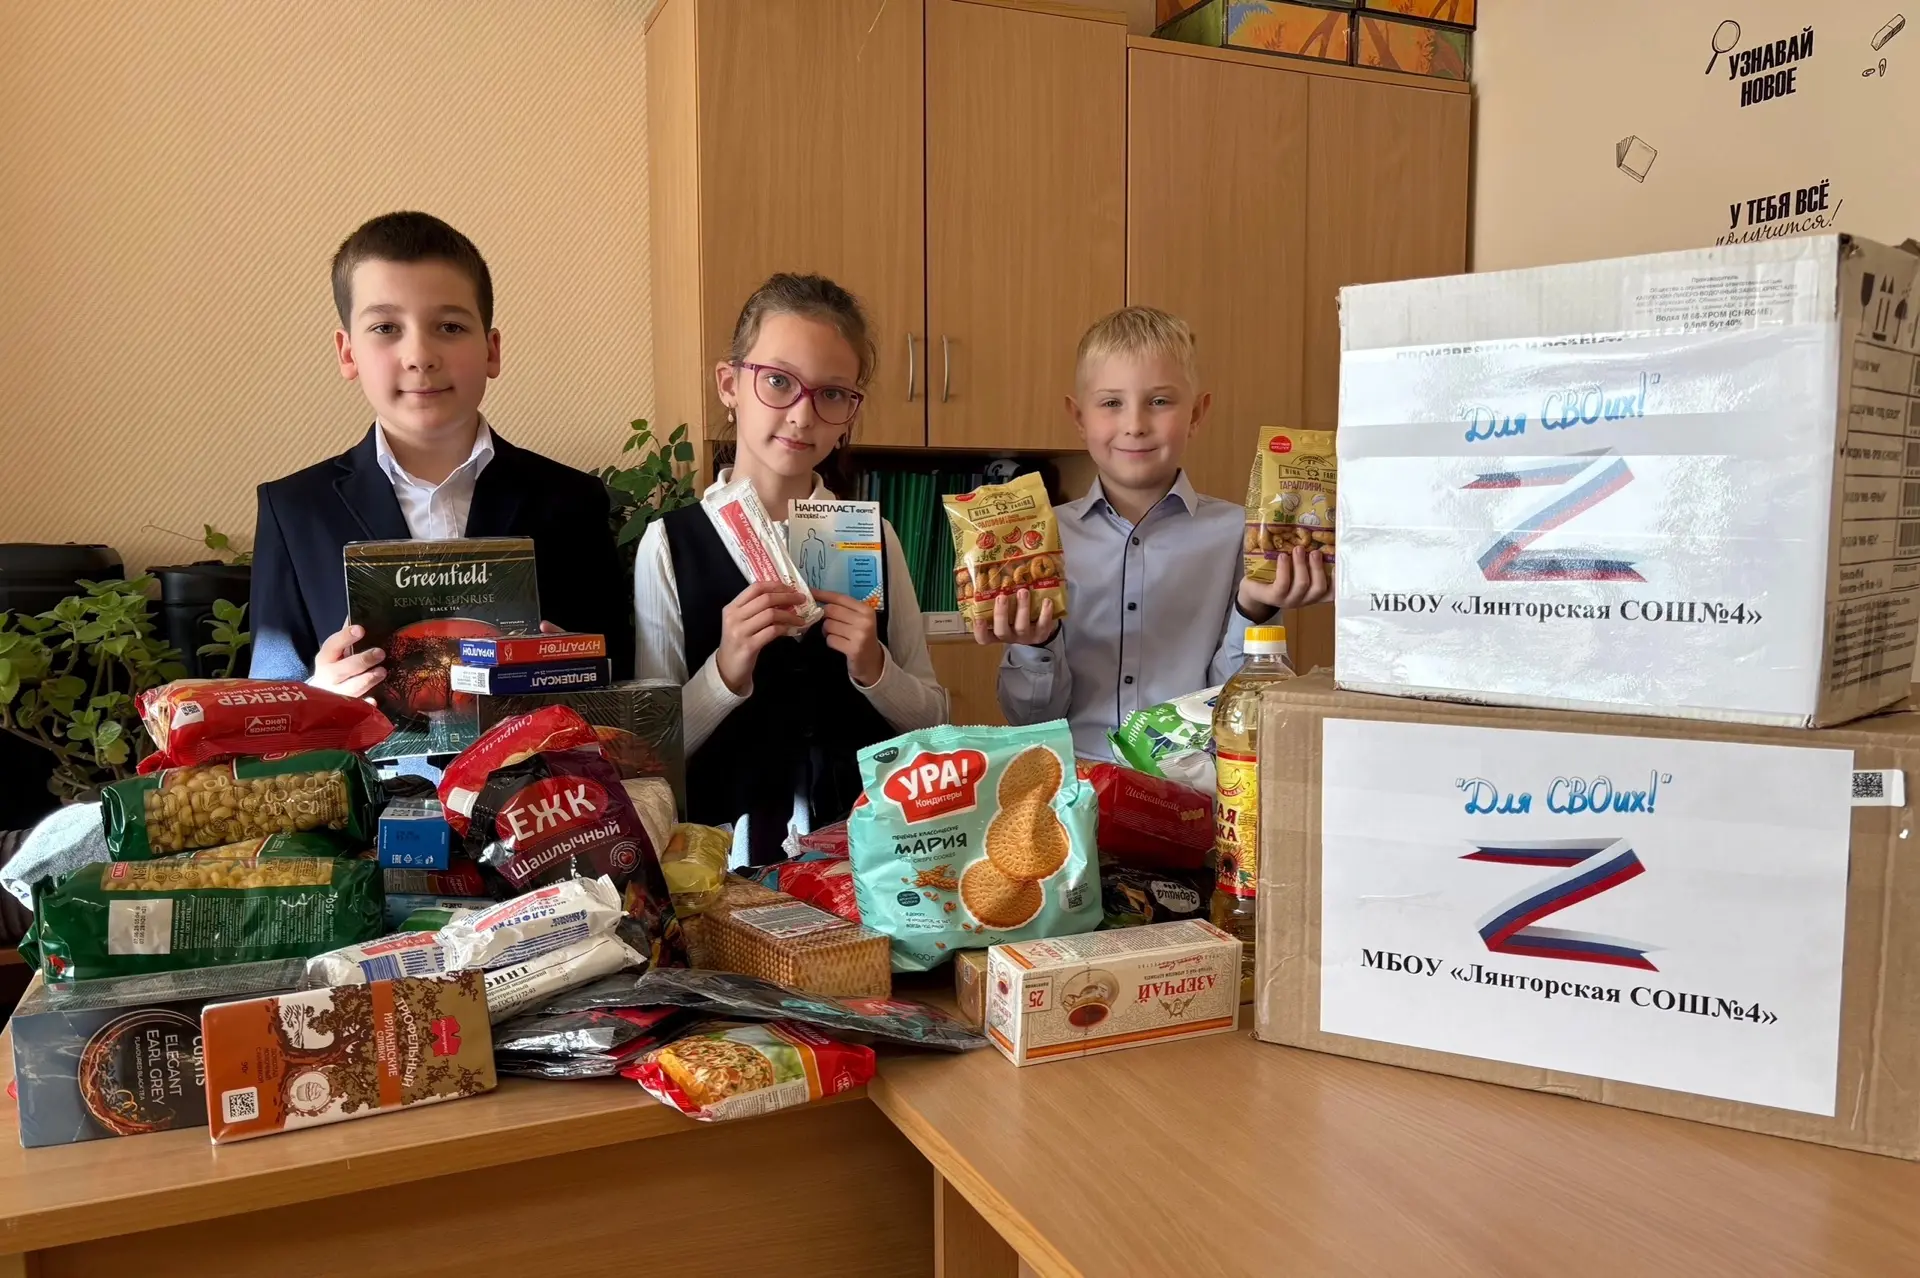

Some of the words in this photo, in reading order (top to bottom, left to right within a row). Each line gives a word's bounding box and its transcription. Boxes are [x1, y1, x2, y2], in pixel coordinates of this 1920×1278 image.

[1728, 25, 1814, 81] УЗНАВАЙ
[1740, 67, 1798, 108] НОВОЕ
[1729, 203, 1742, 229] У
[1746, 191, 1791, 225] ТЕБЯ
[1795, 178, 1830, 216] ВСЁ
[1656, 314, 1680, 322] Водка
[795, 499, 855, 514] НАНОПЛАСТ
[395, 562, 488, 588] Greenfield
[394, 595, 441, 608] KENYAN
[445, 593, 495, 606] SUNRISE
[1369, 592, 1445, 613] МБОУ
[1451, 595, 1611, 623] «Лянторская
[1620, 598, 1763, 627] СОШ№4»
[462, 646, 495, 659] НУРАЛГОН
[539, 640, 601, 656] НУРАЛГОН
[532, 672, 598, 687] ВЕЛДЕКСАЛ
[217, 690, 307, 707] КРЕКЕР
[480, 714, 533, 755] Спирали
[897, 758, 968, 800] УРА!
[506, 784, 596, 841] ЕЖК
[915, 791, 962, 809] Кондитеры
[510, 821, 621, 880] Шашлычный
[490, 908, 557, 933] САЛФЕТКИ
[499, 995, 516, 1008] ГОСТ
[1029, 990, 1044, 1008] 25
[1138, 973, 1218, 1003] АЗЕРЧАЙ
[1361, 947, 1444, 979] МБОУ
[1449, 961, 1621, 1005] «Лянторская
[1630, 985, 1779, 1027] СОШ№4»
[134, 1036, 143, 1071] FLAVOURED
[146, 1029, 162, 1067] EARL
[376, 1030, 386, 1062] СЛИВКИ
[384, 1012, 398, 1078] ИРЛАНДСКИЕ
[395, 996, 419, 1088] ТРЮФЕЛЬНЫЙ
[164, 1034, 183, 1096] ELEGANT
[149, 1068, 165, 1105] GREY
